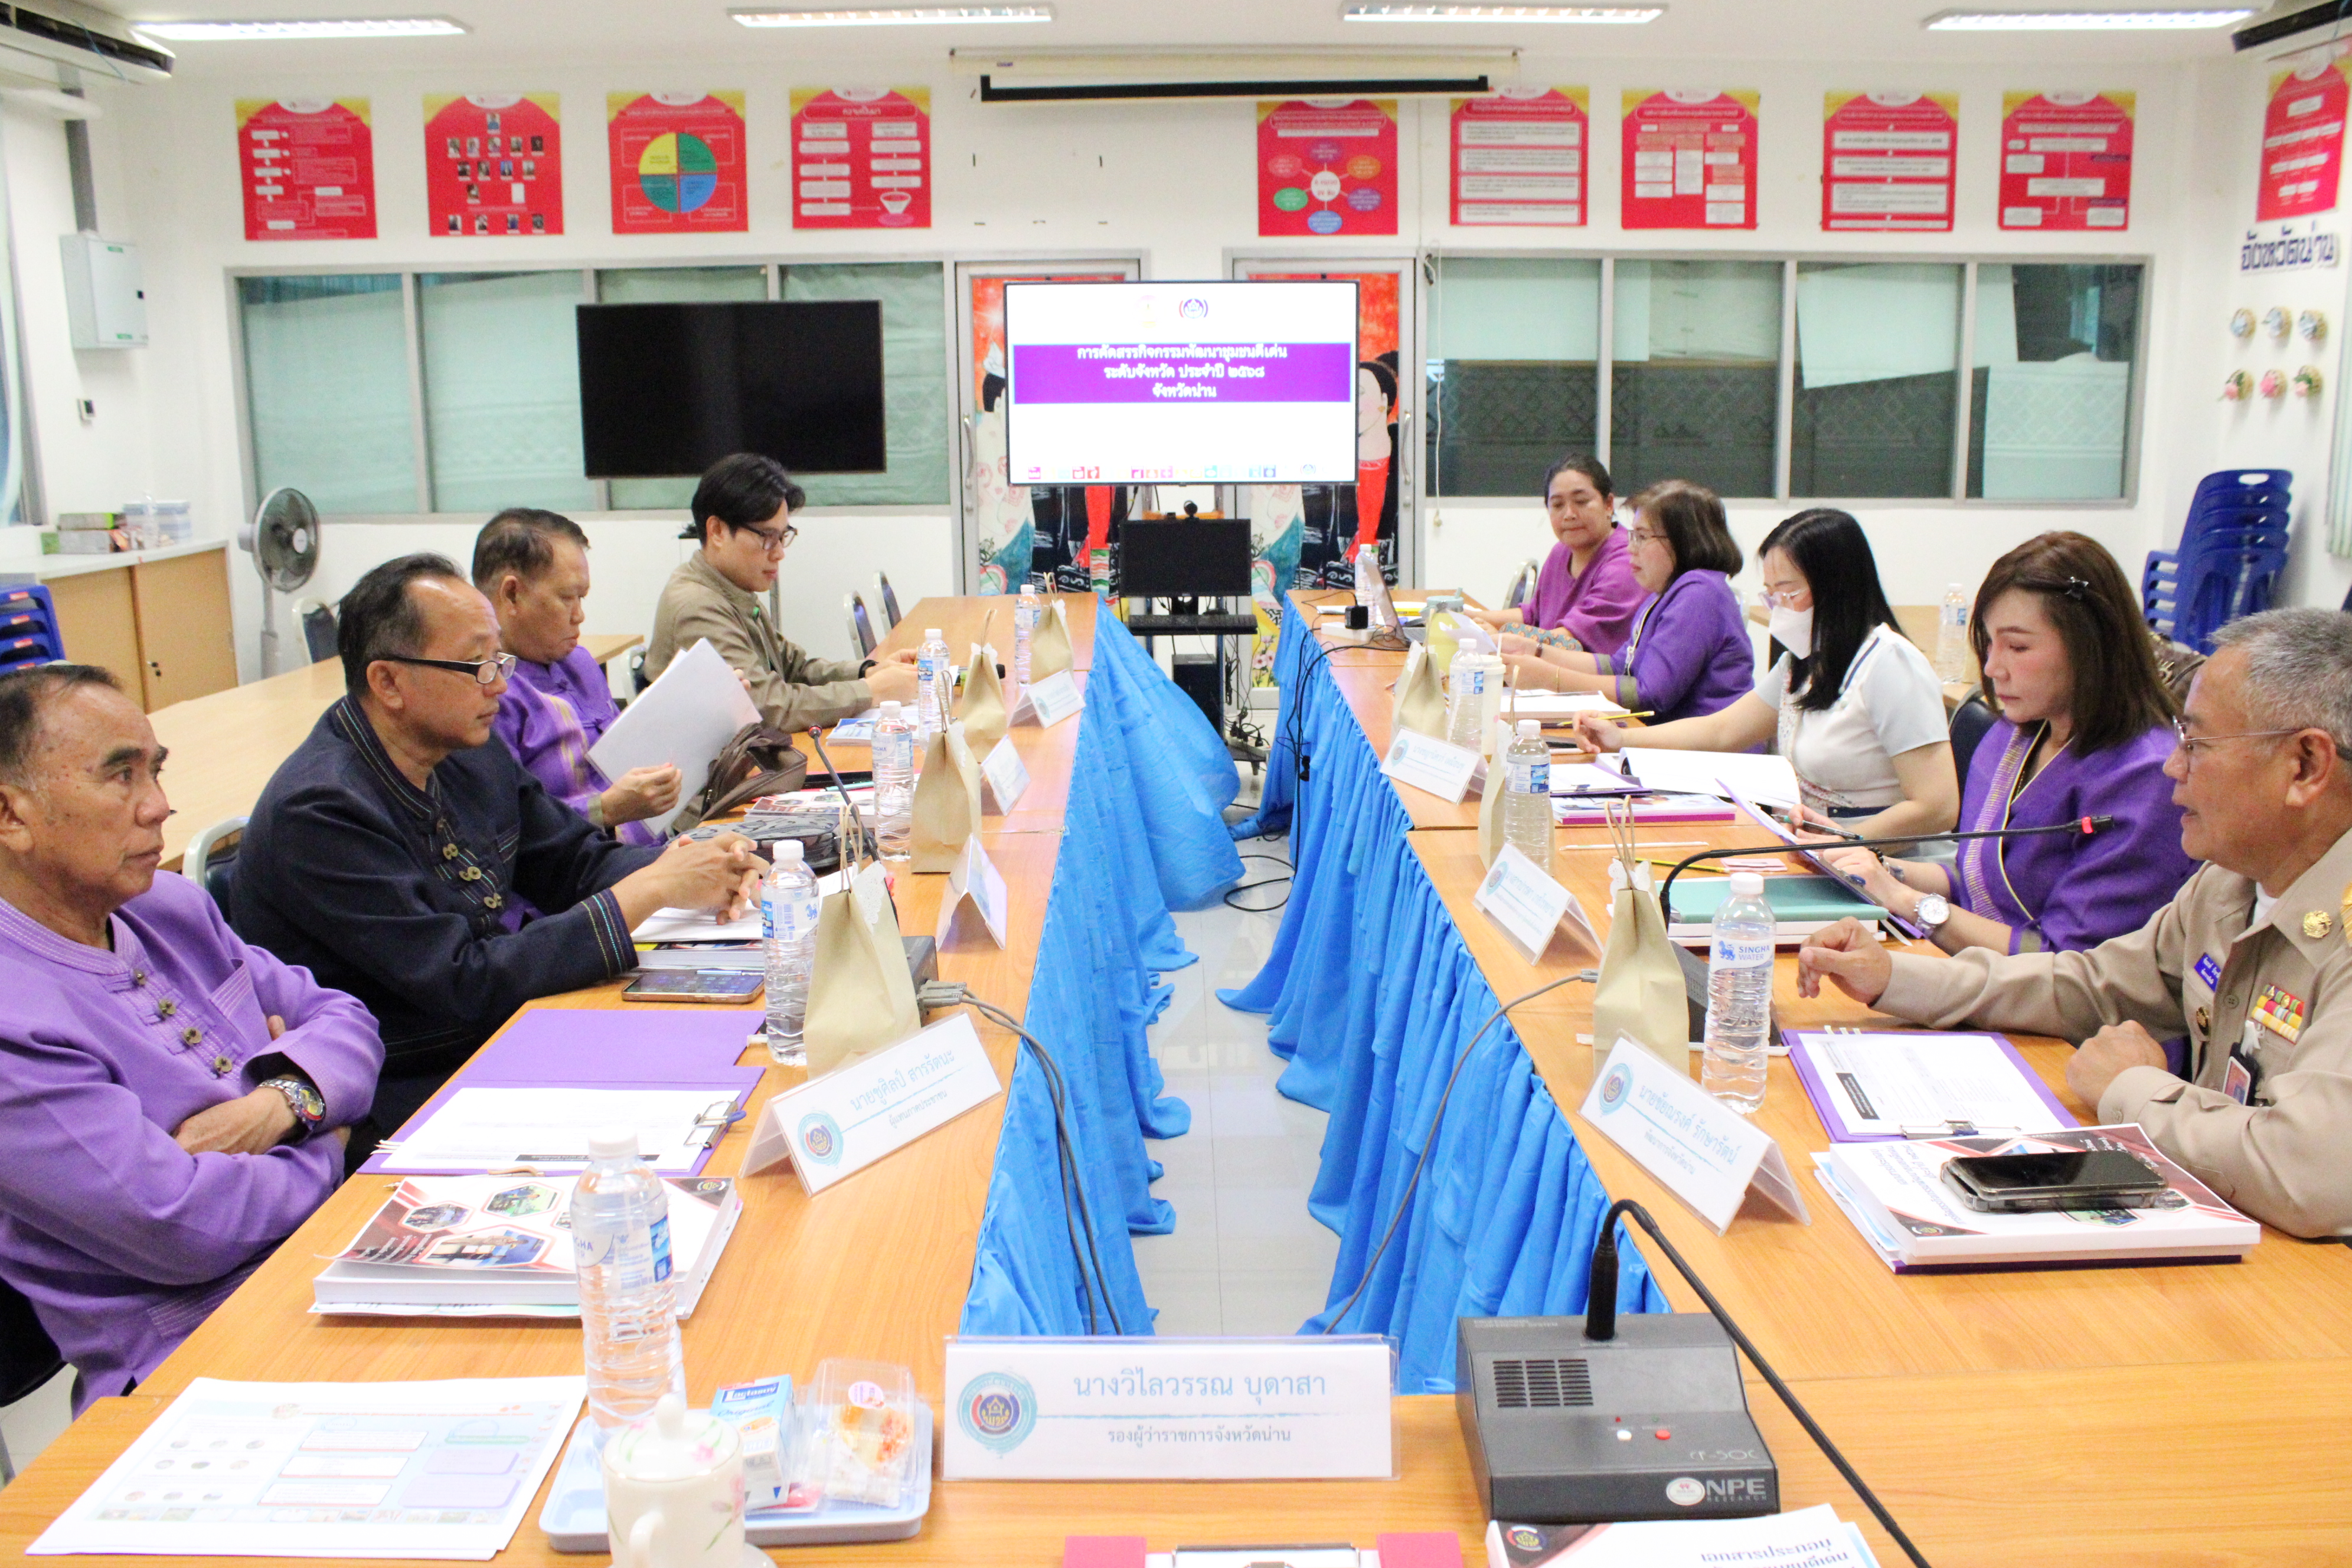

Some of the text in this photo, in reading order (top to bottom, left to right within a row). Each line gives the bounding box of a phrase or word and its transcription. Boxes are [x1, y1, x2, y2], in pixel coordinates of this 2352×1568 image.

[1077, 344, 1287, 362] การคัดสรรกิจกรรมพัฒนาชุมชนดีเด่น
[1104, 363, 1175, 378] ระดับจังหวัด
[1179, 363, 1224, 378] ประจำปี
[1152, 383, 1216, 398] จังหวัดน่าน
[1739, 945, 1770, 953] SINGHA
[1739, 953, 1764, 961] WATER
[724, 1386, 777, 1402] Lactasoy
[1074, 1367, 1326, 1405] นางวิไลวรรณ บุดาสา
[1108, 1425, 1291, 1448] รองผู้ว่าราชการจังหวัดน่าน
[1706, 1478, 1766, 1495] NPE
[1701, 1538, 1831, 1563] เอกสารประกอบ
